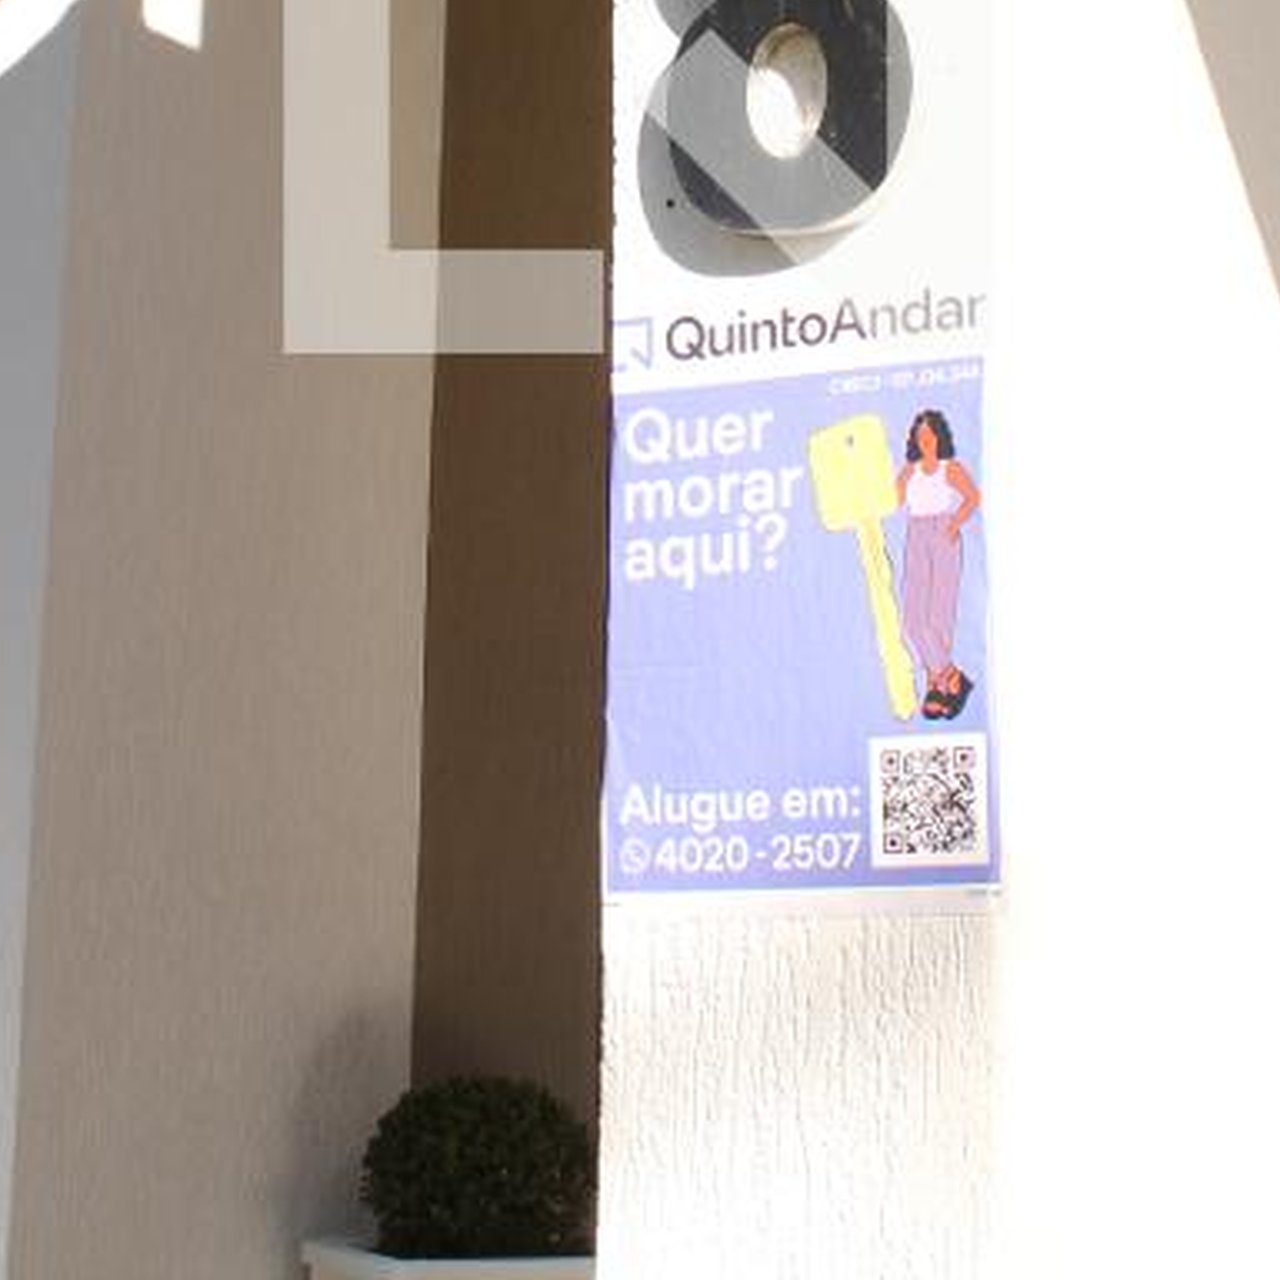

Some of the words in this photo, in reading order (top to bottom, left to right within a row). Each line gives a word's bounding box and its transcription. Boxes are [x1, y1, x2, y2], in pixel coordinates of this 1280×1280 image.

[666, 287, 986, 361] QuintoAndar
[625, 405, 774, 464] Quer
[625, 464, 803, 523] morar
[625, 513, 787, 589] aqui?
[621, 783, 770, 830] Alugue
[783, 785, 860, 820] em:
